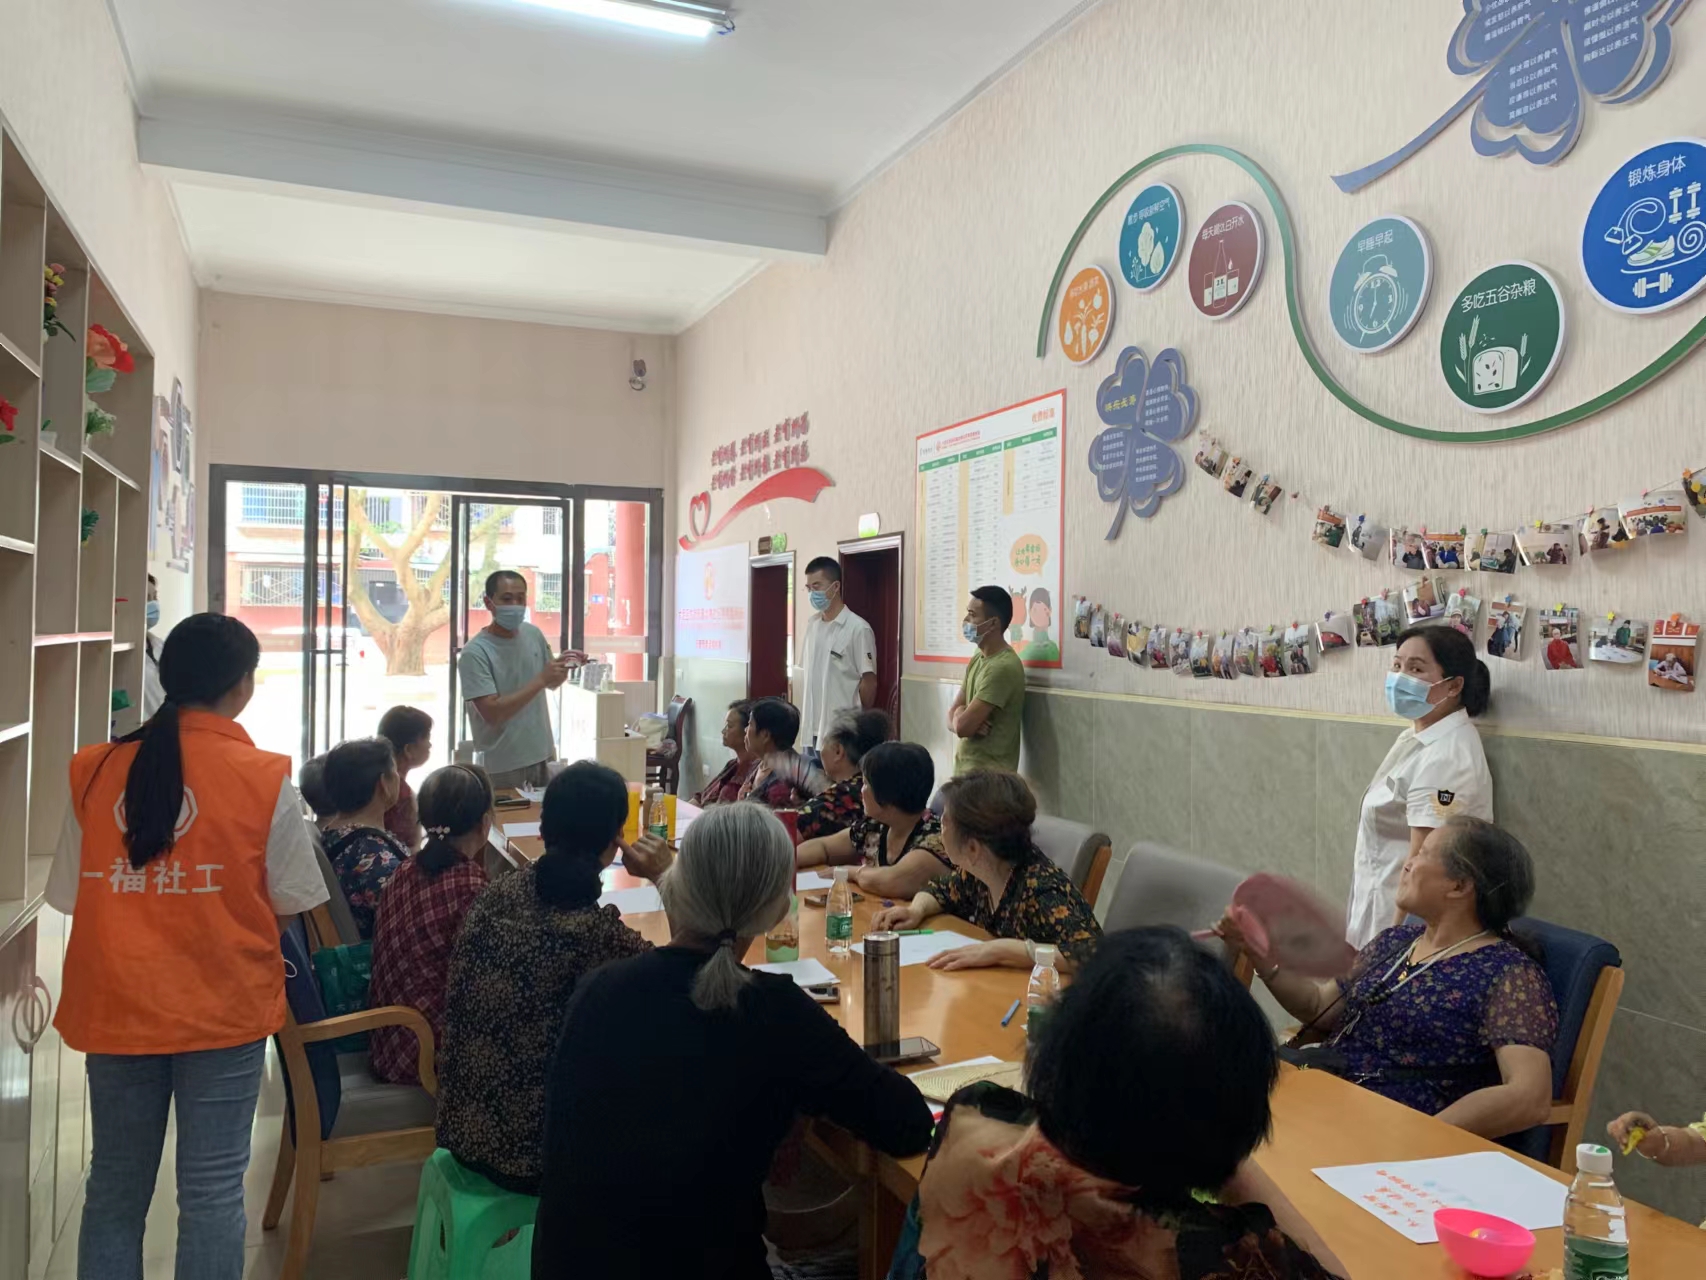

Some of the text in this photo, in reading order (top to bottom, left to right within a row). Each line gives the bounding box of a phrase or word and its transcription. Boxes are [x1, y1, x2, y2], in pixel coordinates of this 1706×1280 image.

[1628, 154, 1686, 188] 锻炼身体
[1357, 229, 1393, 252] 早睡早起
[1461, 278, 1537, 313] 多吃五谷杂粮
[82, 857, 224, 895] 一福社工
